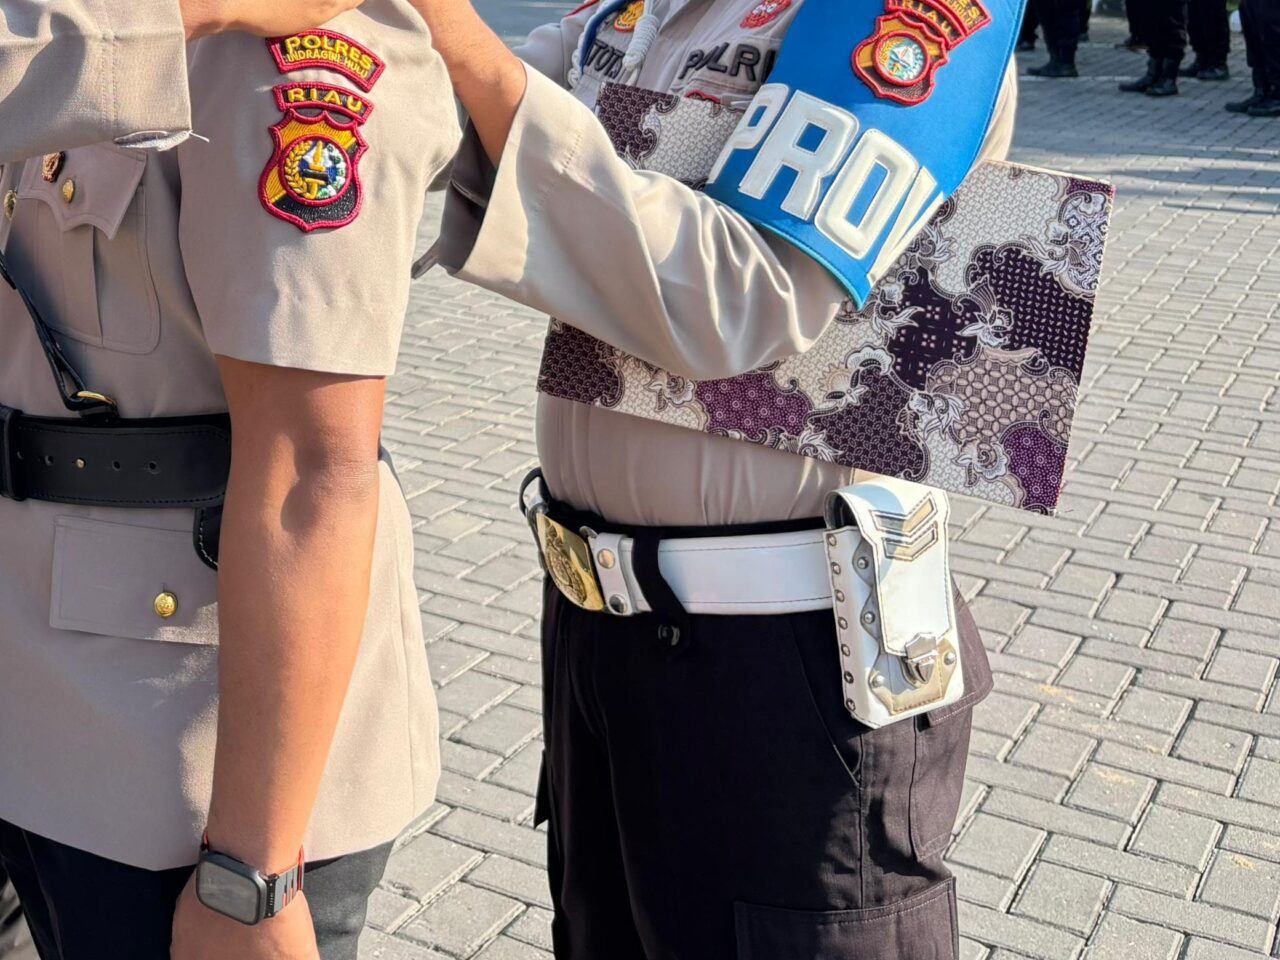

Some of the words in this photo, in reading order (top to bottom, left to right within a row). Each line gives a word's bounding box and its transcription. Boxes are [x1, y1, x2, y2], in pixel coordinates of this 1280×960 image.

[285, 35, 373, 70] POLRES
[287, 49, 341, 63] INDRAGIRI
[344, 58, 368, 78] HULU
[287, 88, 363, 112] RIAU
